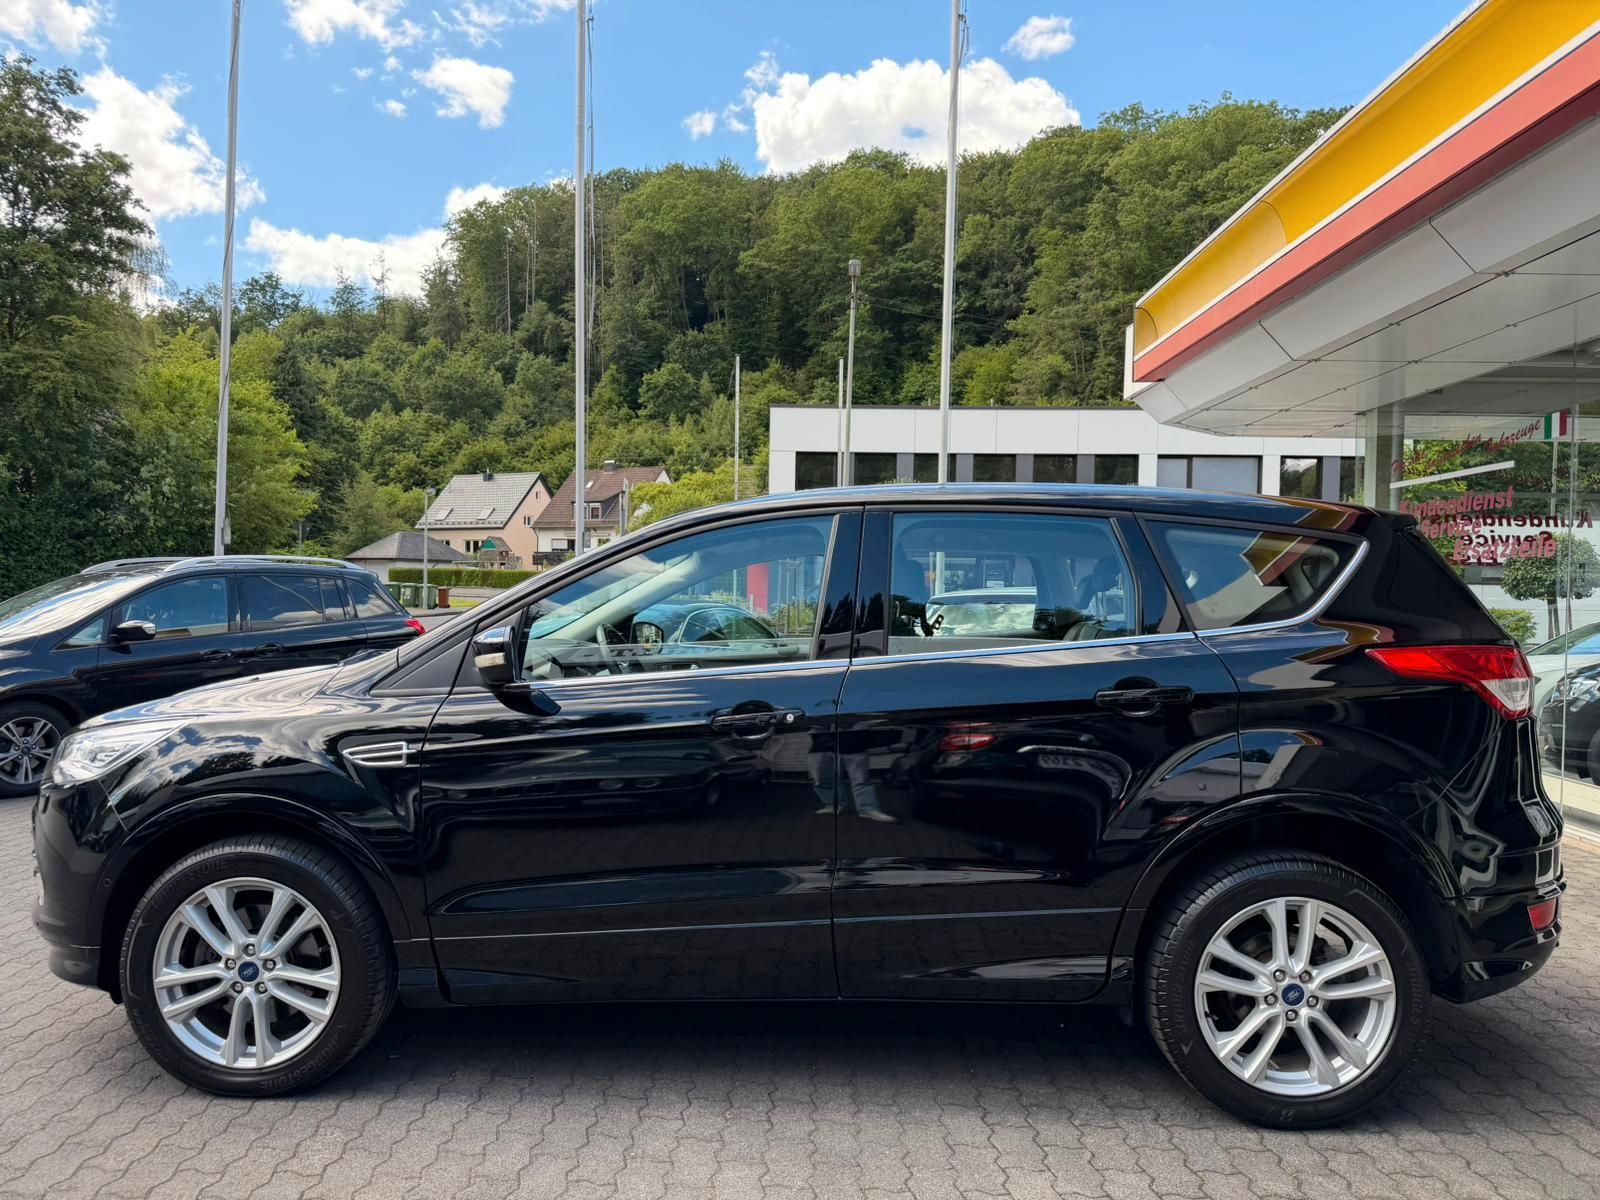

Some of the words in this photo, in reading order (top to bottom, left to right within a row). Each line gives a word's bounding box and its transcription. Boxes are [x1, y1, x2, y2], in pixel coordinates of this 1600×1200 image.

[1399, 486, 1514, 516] Kundendienst
[1420, 517, 1482, 539] Service
[1453, 534, 1557, 561] Ersatzteile
